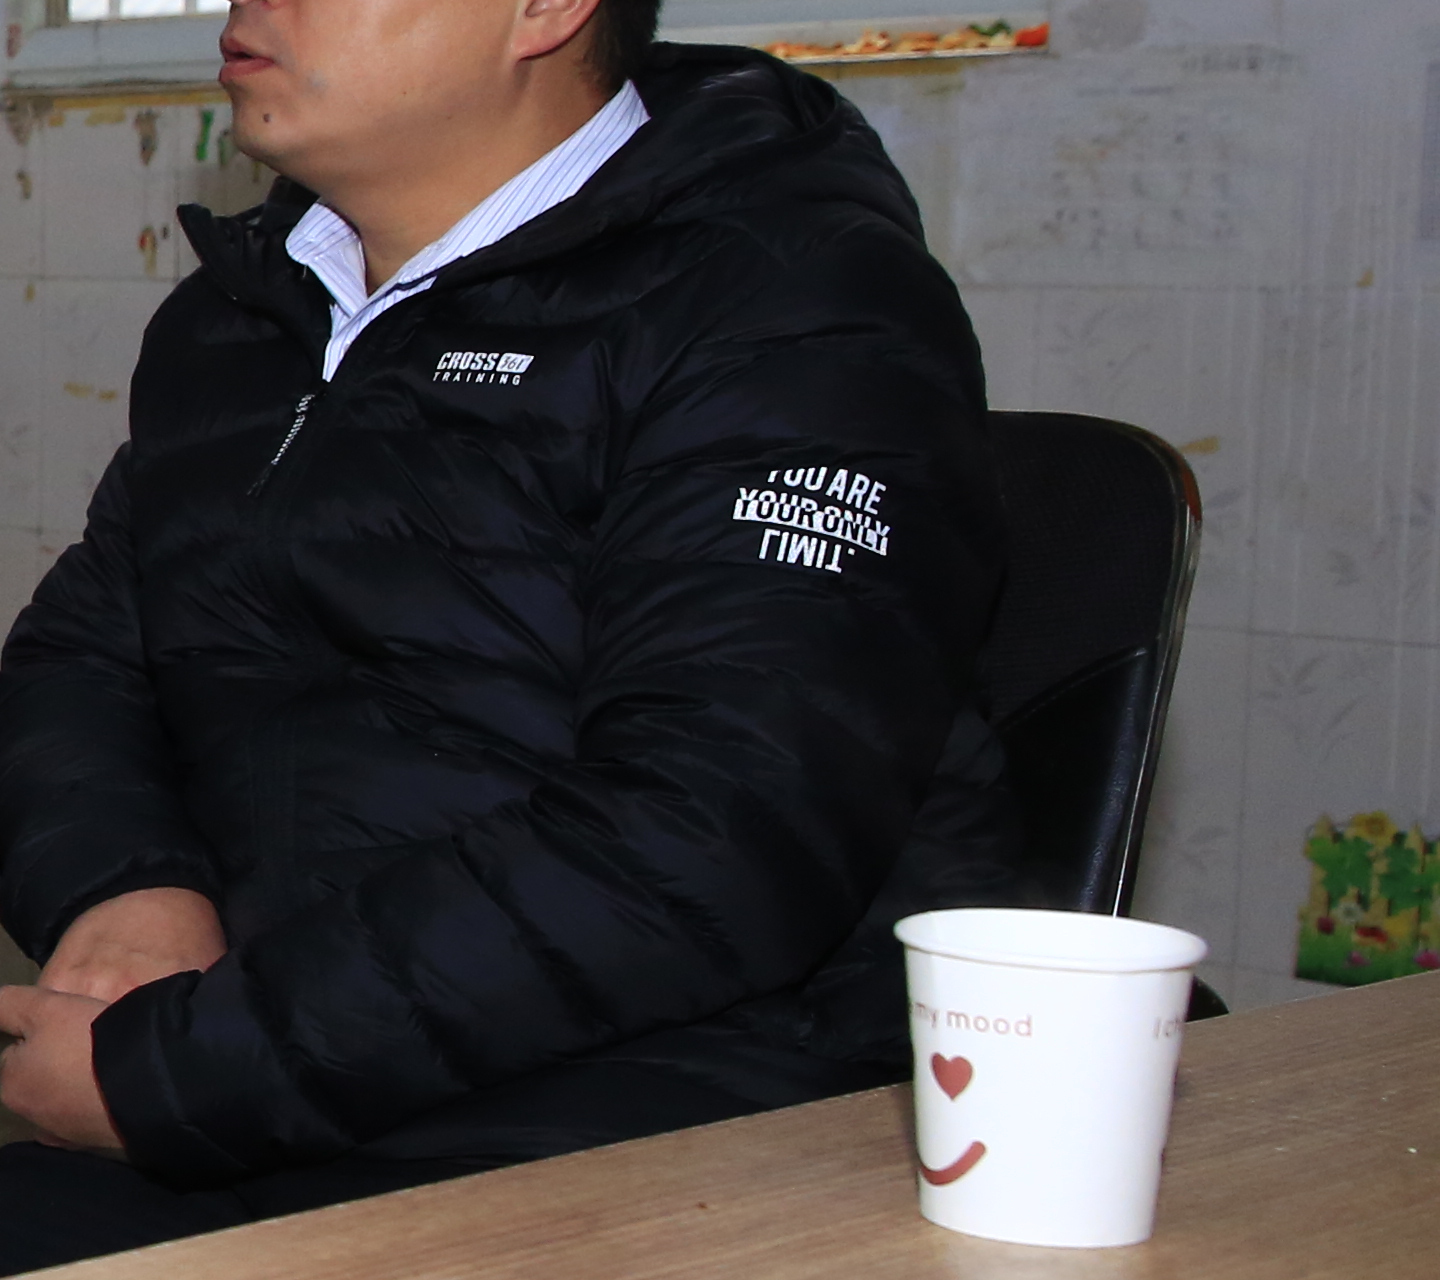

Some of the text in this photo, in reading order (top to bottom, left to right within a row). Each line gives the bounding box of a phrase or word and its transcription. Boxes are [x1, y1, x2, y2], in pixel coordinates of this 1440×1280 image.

[437, 352, 499, 371] CROSS
[433, 372, 521, 385] TRAINING
[825, 468, 886, 515] ARE
[733, 487, 891, 556] YOUR ONLY
[946, 1011, 1033, 1037] mood
